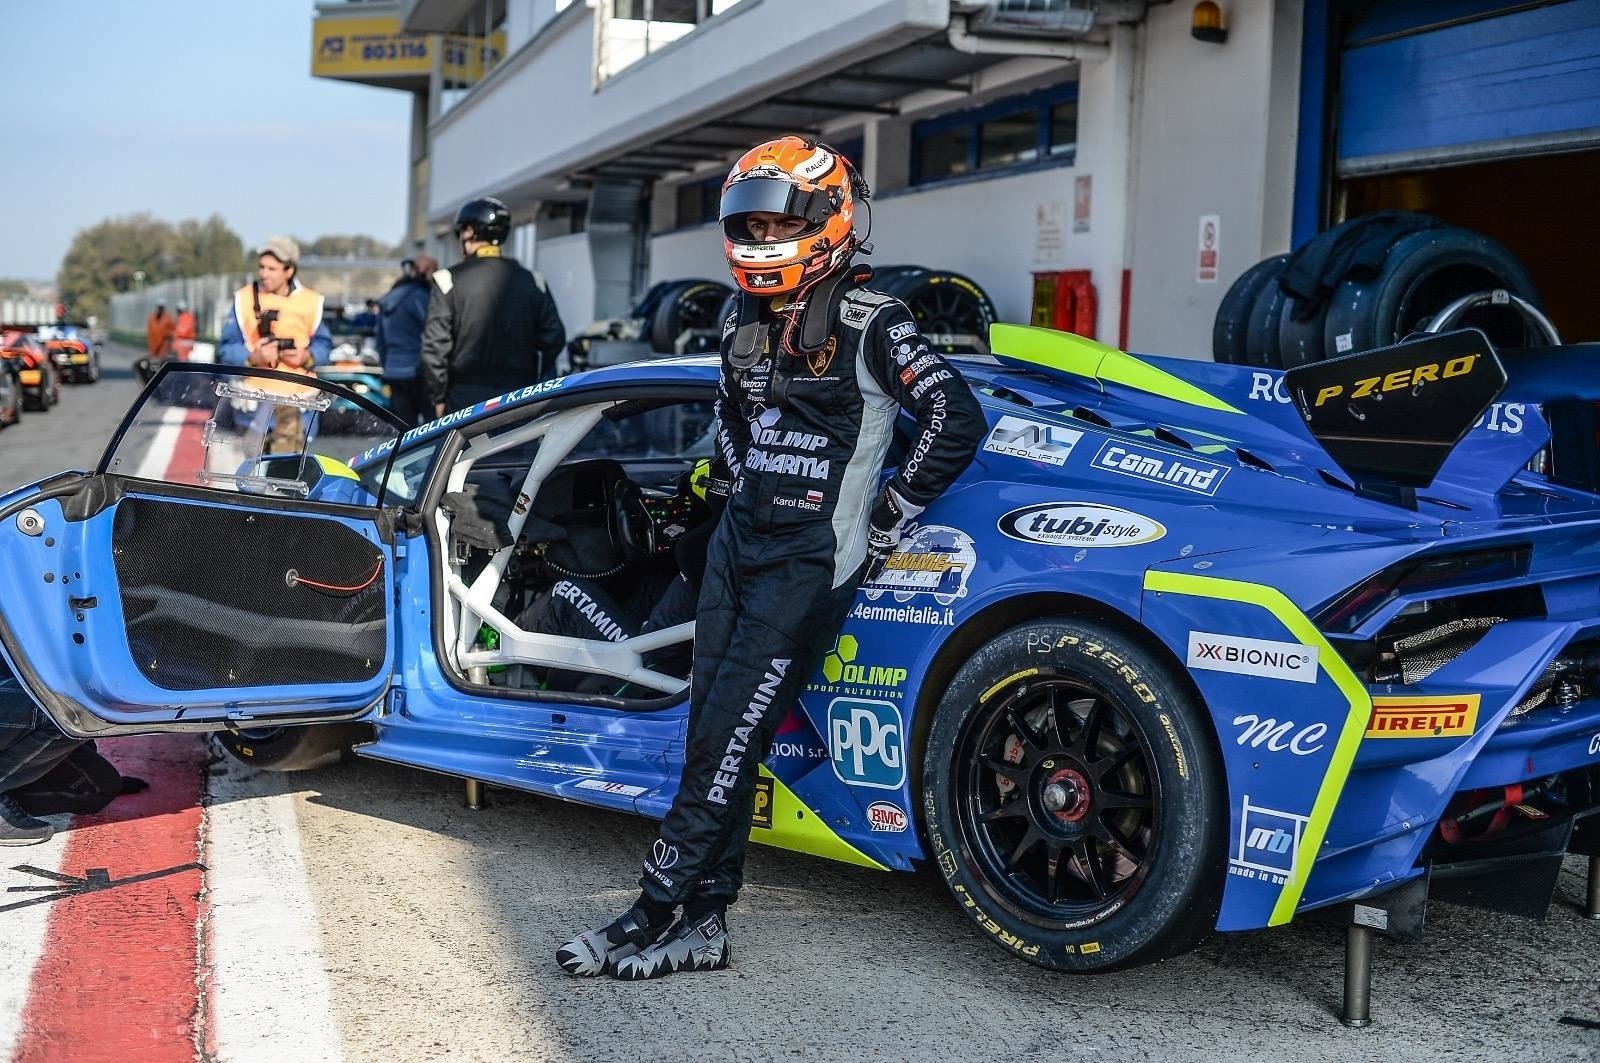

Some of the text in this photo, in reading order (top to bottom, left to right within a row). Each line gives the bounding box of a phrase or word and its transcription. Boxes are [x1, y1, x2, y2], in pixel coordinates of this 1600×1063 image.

[845, 308, 868, 321] OMP
[505, 376, 566, 404] K.BASZ
[1315, 354, 1476, 407] P ZERO
[364, 405, 474, 461] V. POTIGLIONE
[760, 428, 829, 451] OLIMP
[902, 429, 936, 484] ROGER
[985, 443, 1064, 465] AUTOLIFT
[773, 495, 822, 511] Karol Basz
[1028, 512, 1141, 539] tubi style
[847, 602, 955, 626] .4emmeitalia.it
[843, 663, 908, 687] OLIMP
[806, 683, 905, 699] SPORT NUTRITION
[706, 658, 792, 805] PERTAMINA
[832, 708, 900, 776] PPG
[1232, 714, 1328, 756] MC
[871, 808, 904, 827] BMC
[873, 822, 889, 832] Air
[1228, 865, 1255, 879] made
[1258, 870, 1268, 881] in
